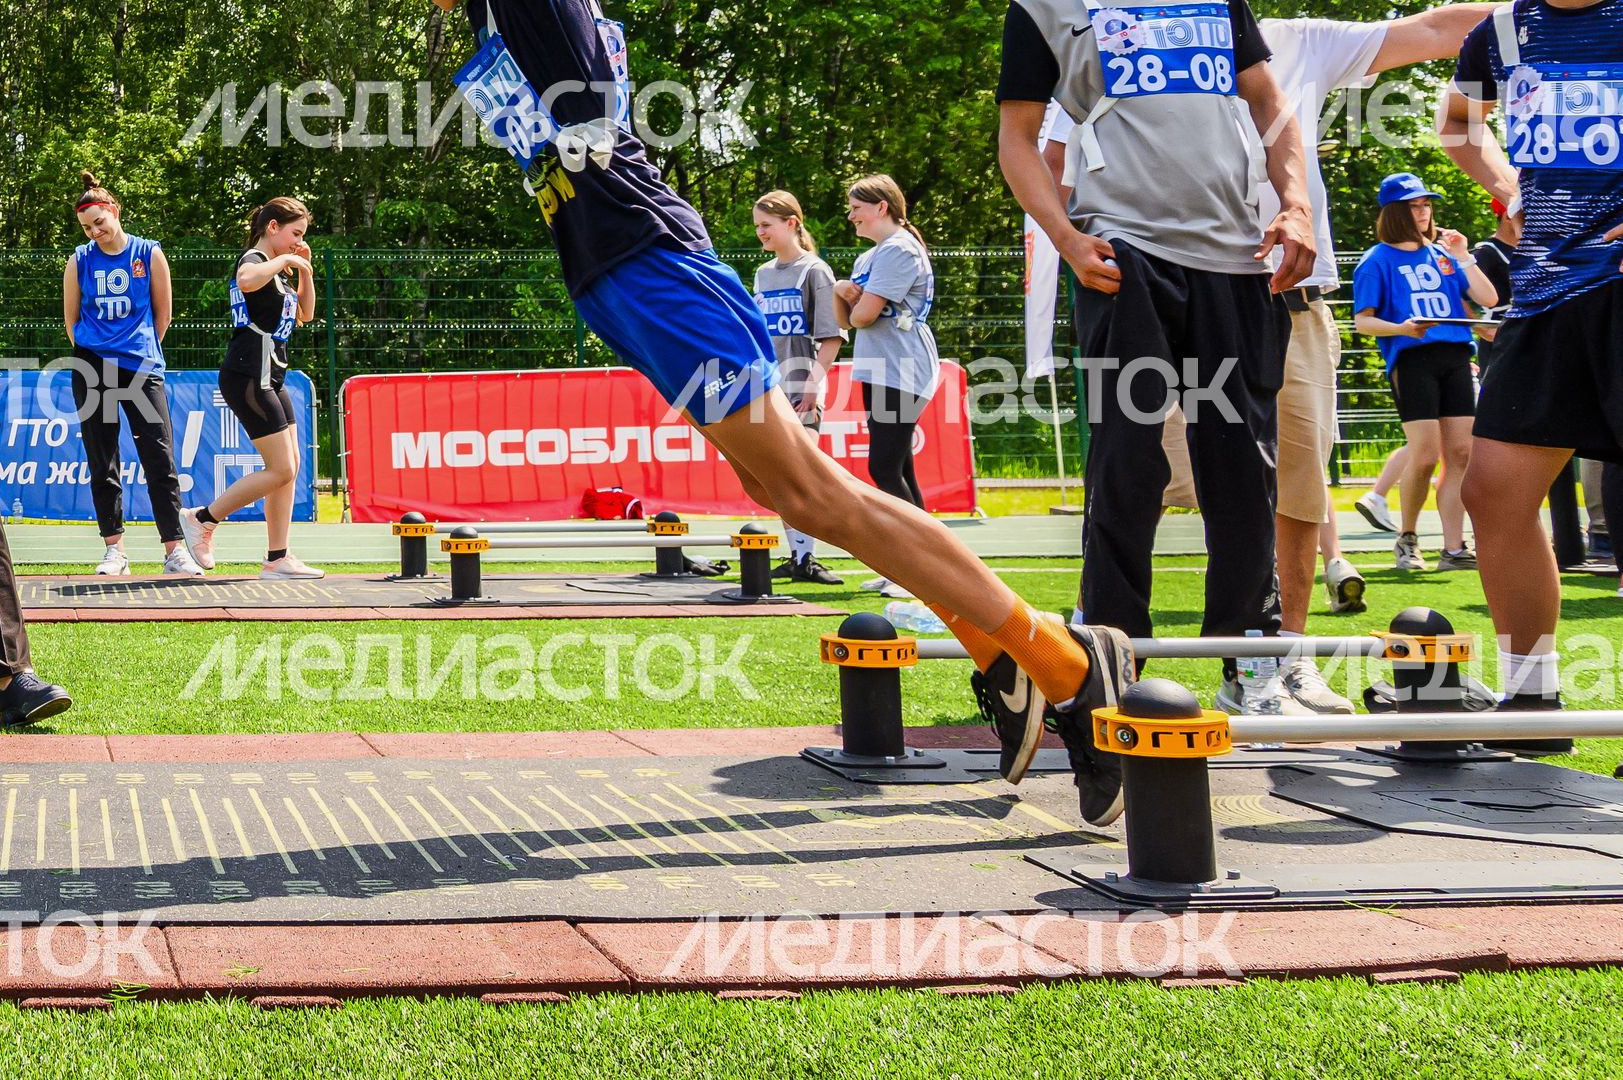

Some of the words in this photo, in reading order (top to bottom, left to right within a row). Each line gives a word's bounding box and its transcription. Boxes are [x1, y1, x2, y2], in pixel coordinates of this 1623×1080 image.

[1107, 53, 1233, 94] 28-08
[1514, 122, 1623, 165] 28-0
[8, 418, 69, 447] ГТО
[858, 648, 908, 660] ГТО
[1151, 731, 1221, 749] ГТО
